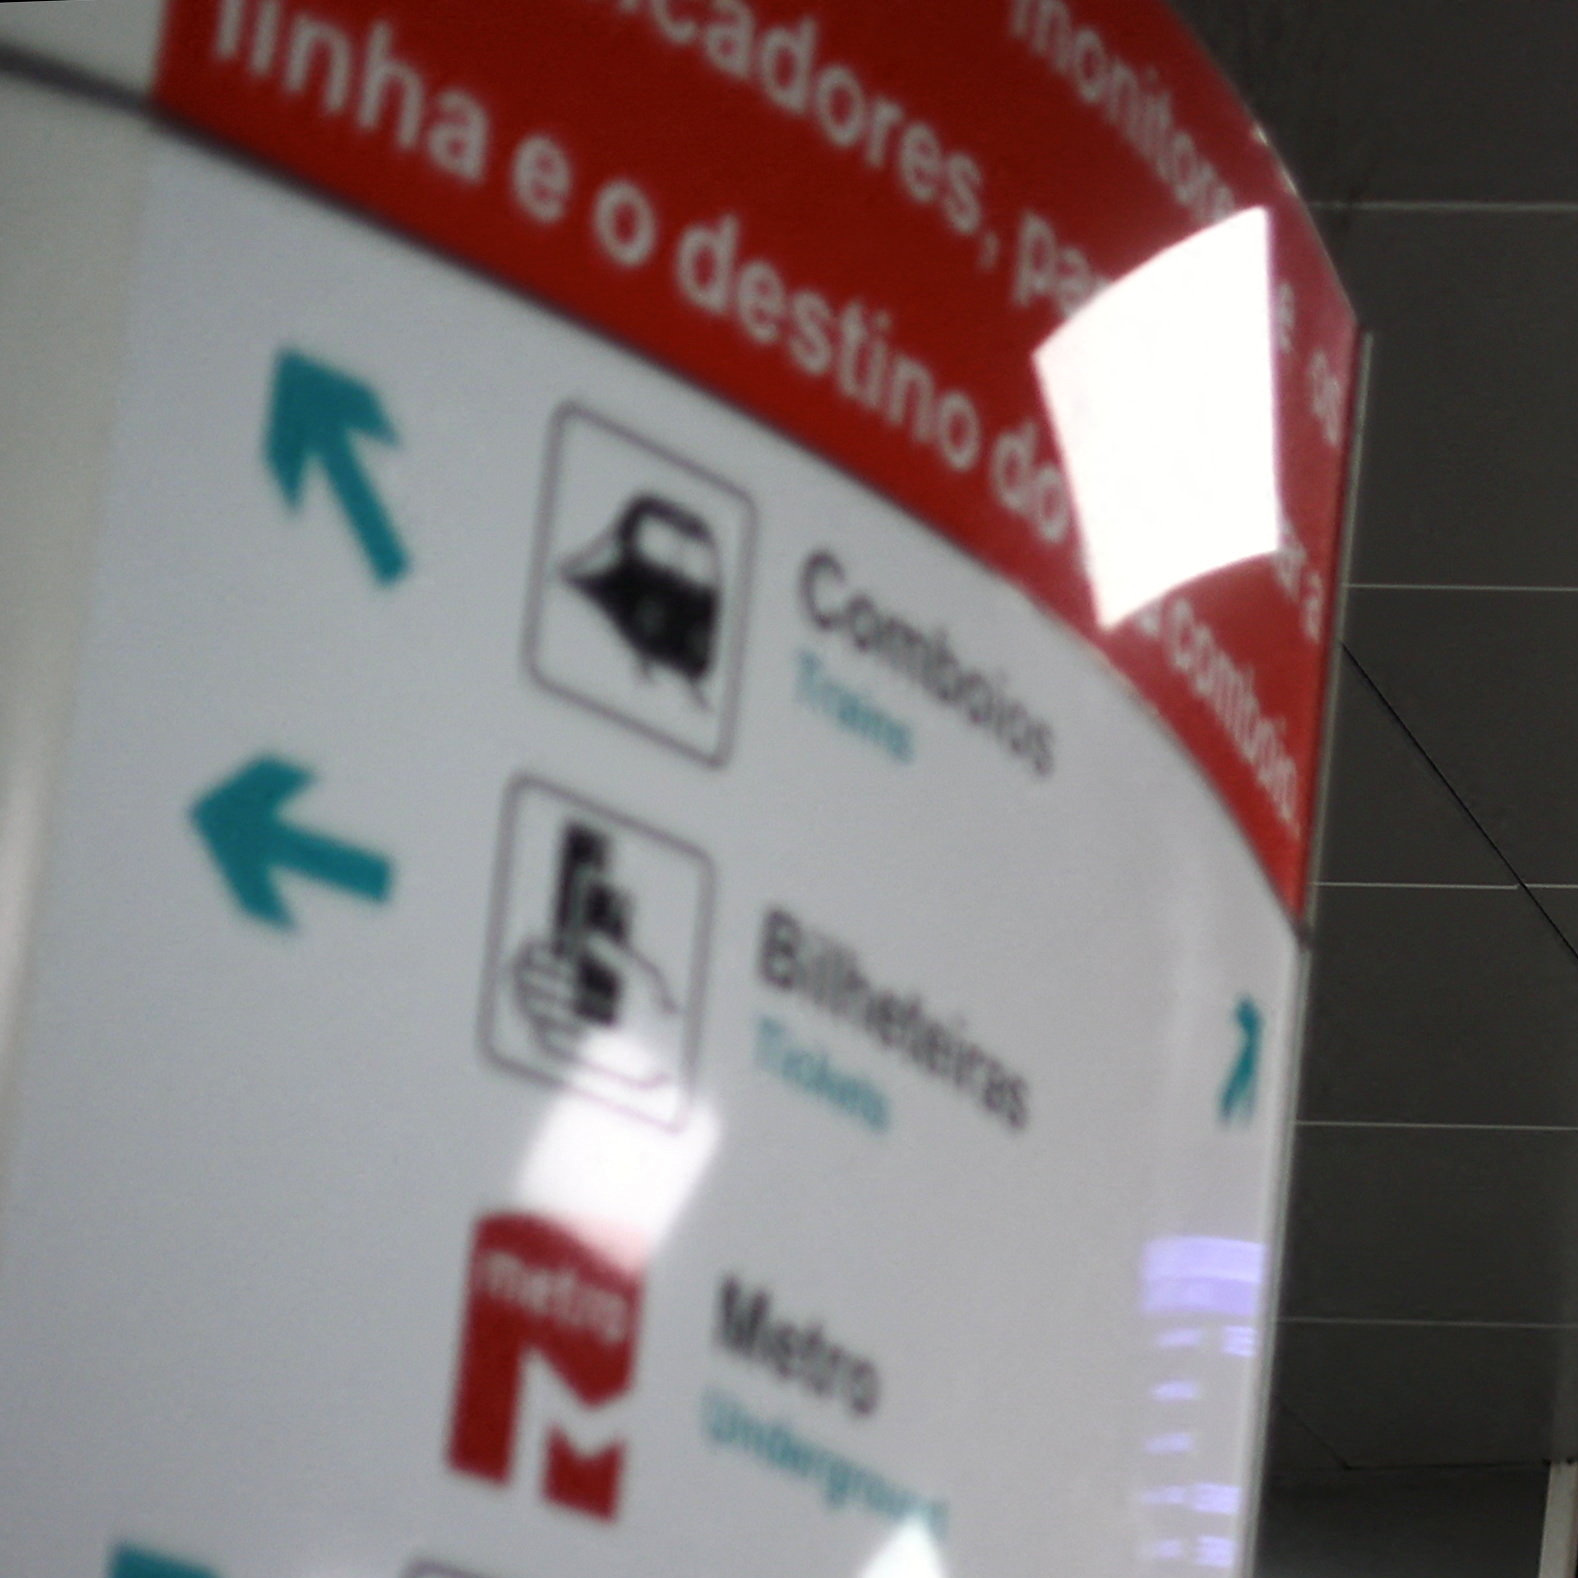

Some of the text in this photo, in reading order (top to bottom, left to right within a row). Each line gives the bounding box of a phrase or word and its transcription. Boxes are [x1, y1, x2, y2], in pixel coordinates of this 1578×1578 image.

[618, 0, 1002, 271] cadores,
[211, 0, 1072, 545] linha e o destino do
[796, 650, 914, 763] Trains
[798, 547, 1053, 776] Comboios
[755, 1013, 891, 1133] Tickets
[757, 902, 1029, 1131] Bilheteiras
[480, 1250, 630, 1346] metro
[714, 1273, 881, 1418] Metro
